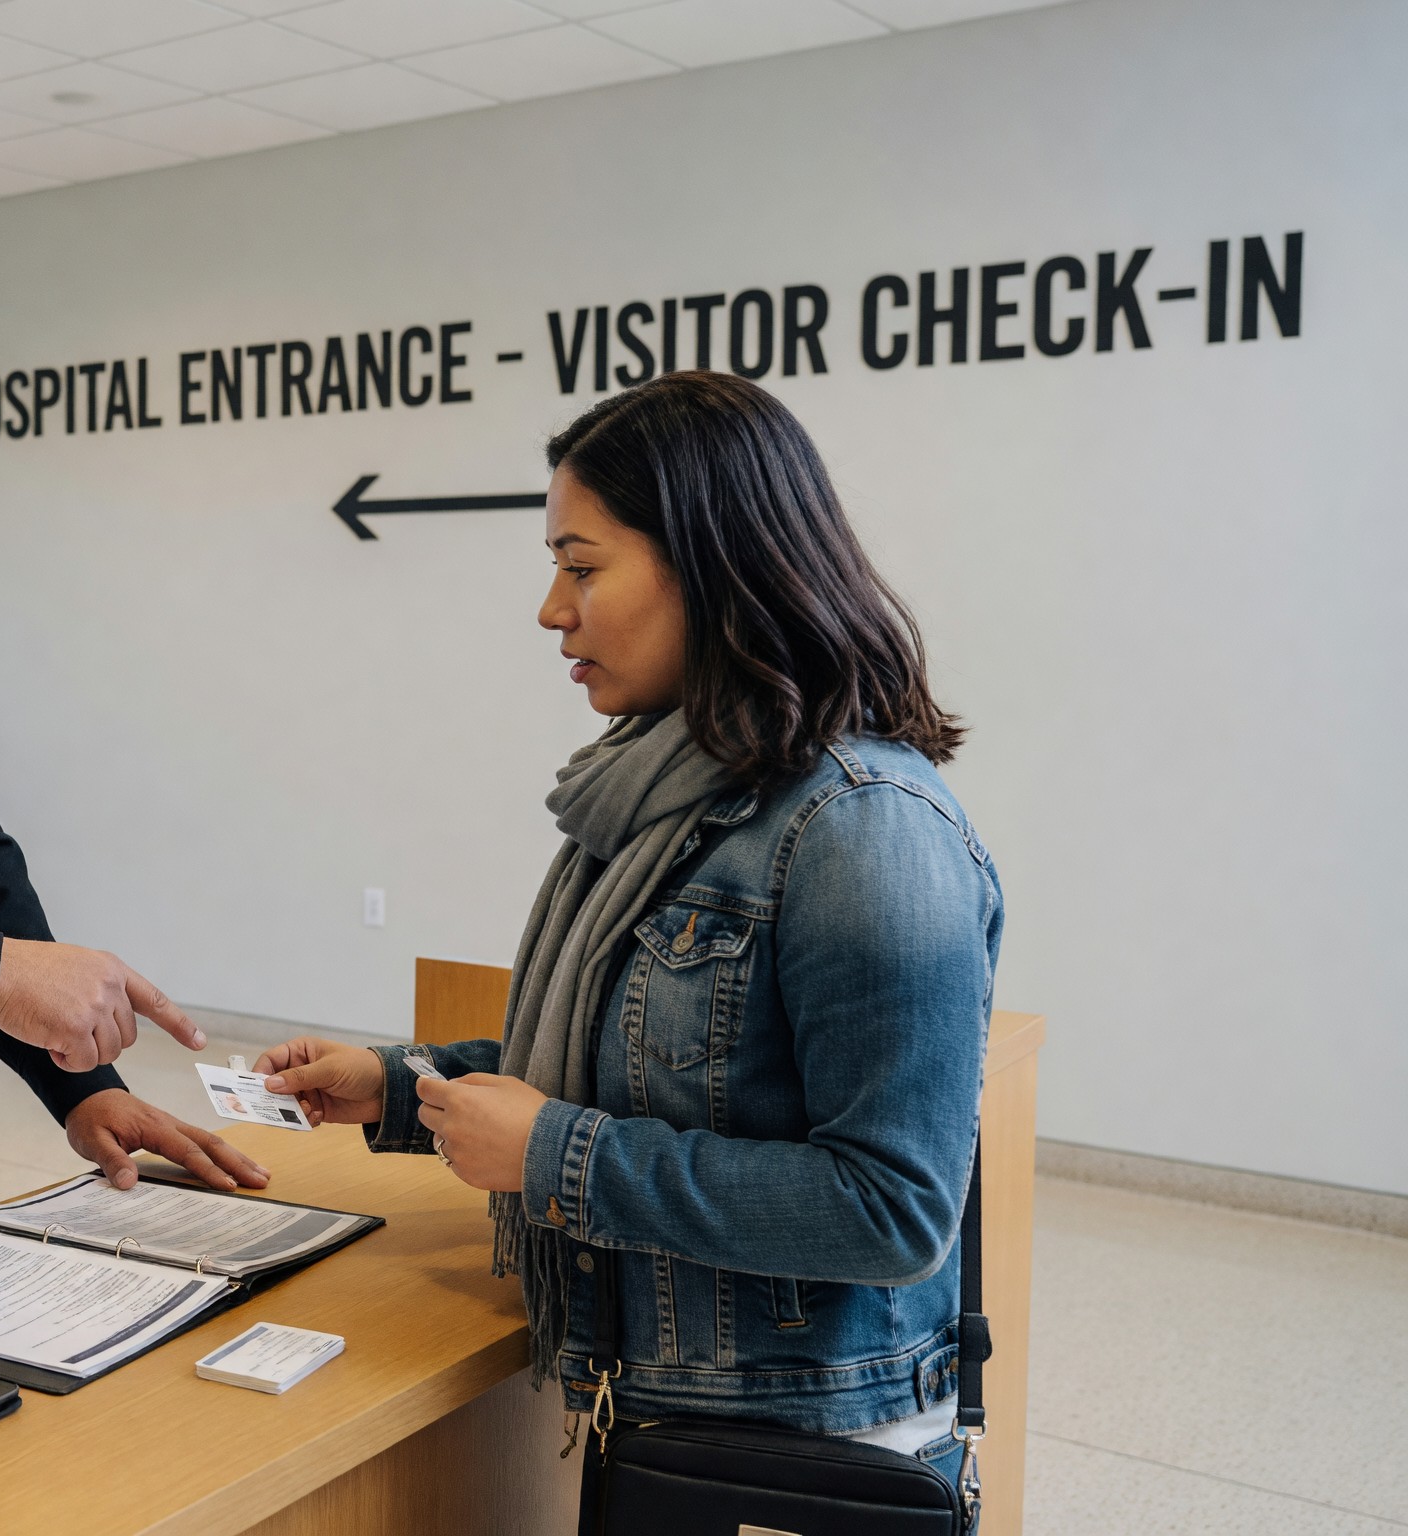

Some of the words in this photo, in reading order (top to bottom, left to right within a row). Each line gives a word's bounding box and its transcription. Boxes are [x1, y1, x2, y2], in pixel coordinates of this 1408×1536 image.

[179, 321, 473, 426] ENTRANCE
[547, 284, 829, 395] VISITOR
[860, 231, 1304, 371] CHECK-IN
